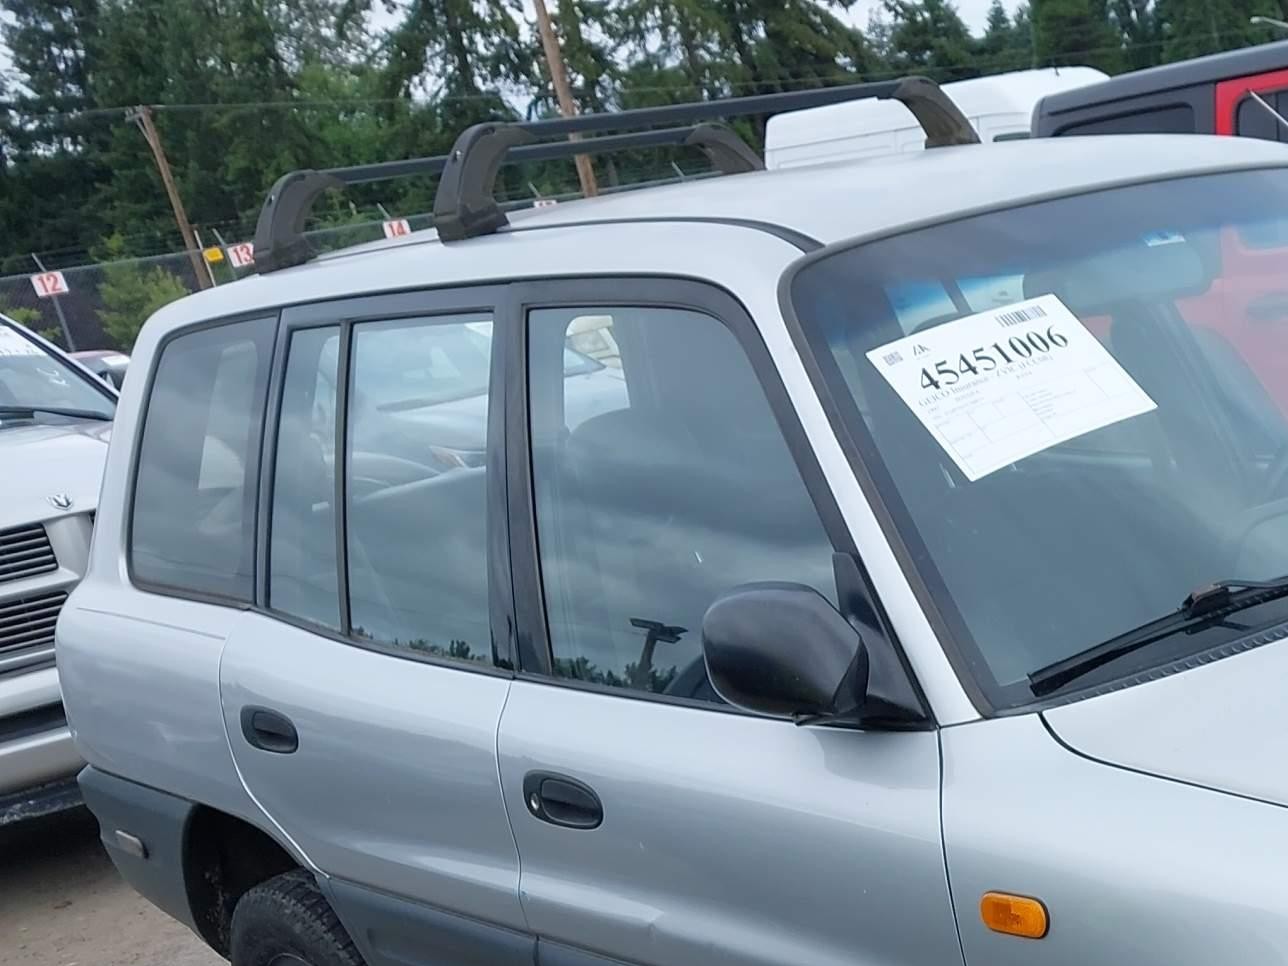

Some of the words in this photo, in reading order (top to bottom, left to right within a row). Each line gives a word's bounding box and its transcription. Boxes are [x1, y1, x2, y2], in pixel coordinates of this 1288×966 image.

[389, 221, 406, 236] 14
[234, 244, 252, 265] 13
[38, 273, 62, 293] 12
[919, 325, 1068, 390] 45451006
